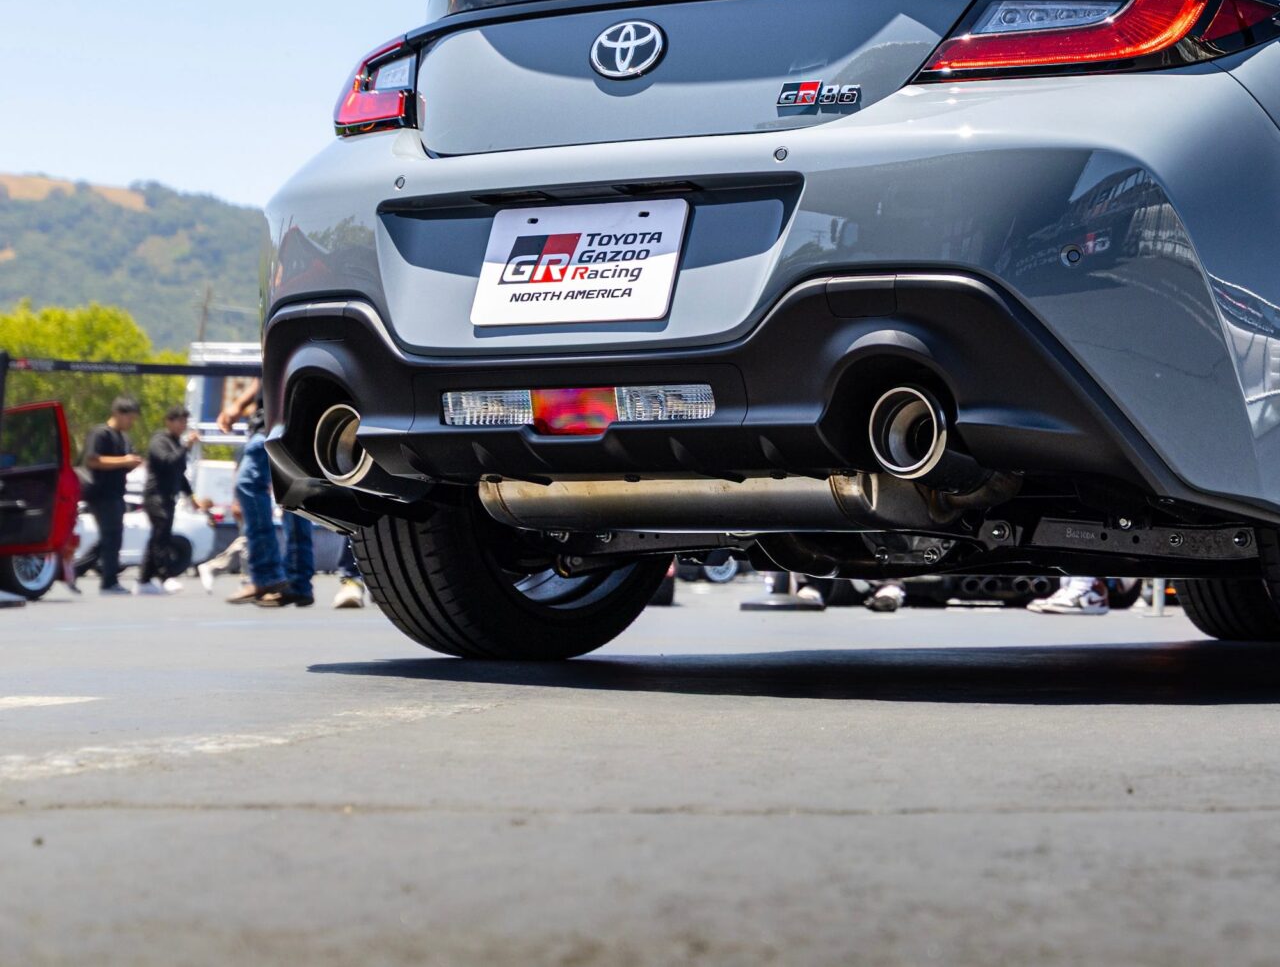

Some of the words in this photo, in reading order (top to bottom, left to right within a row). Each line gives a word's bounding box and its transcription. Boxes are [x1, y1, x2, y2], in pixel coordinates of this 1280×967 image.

[586, 231, 663, 247] TOYOTA
[577, 249, 651, 264] GAZOO
[502, 253, 571, 283] GR
[571, 264, 643, 282] Racing
[510, 291, 562, 303] NORTH
[563, 288, 633, 301] AMERICA
